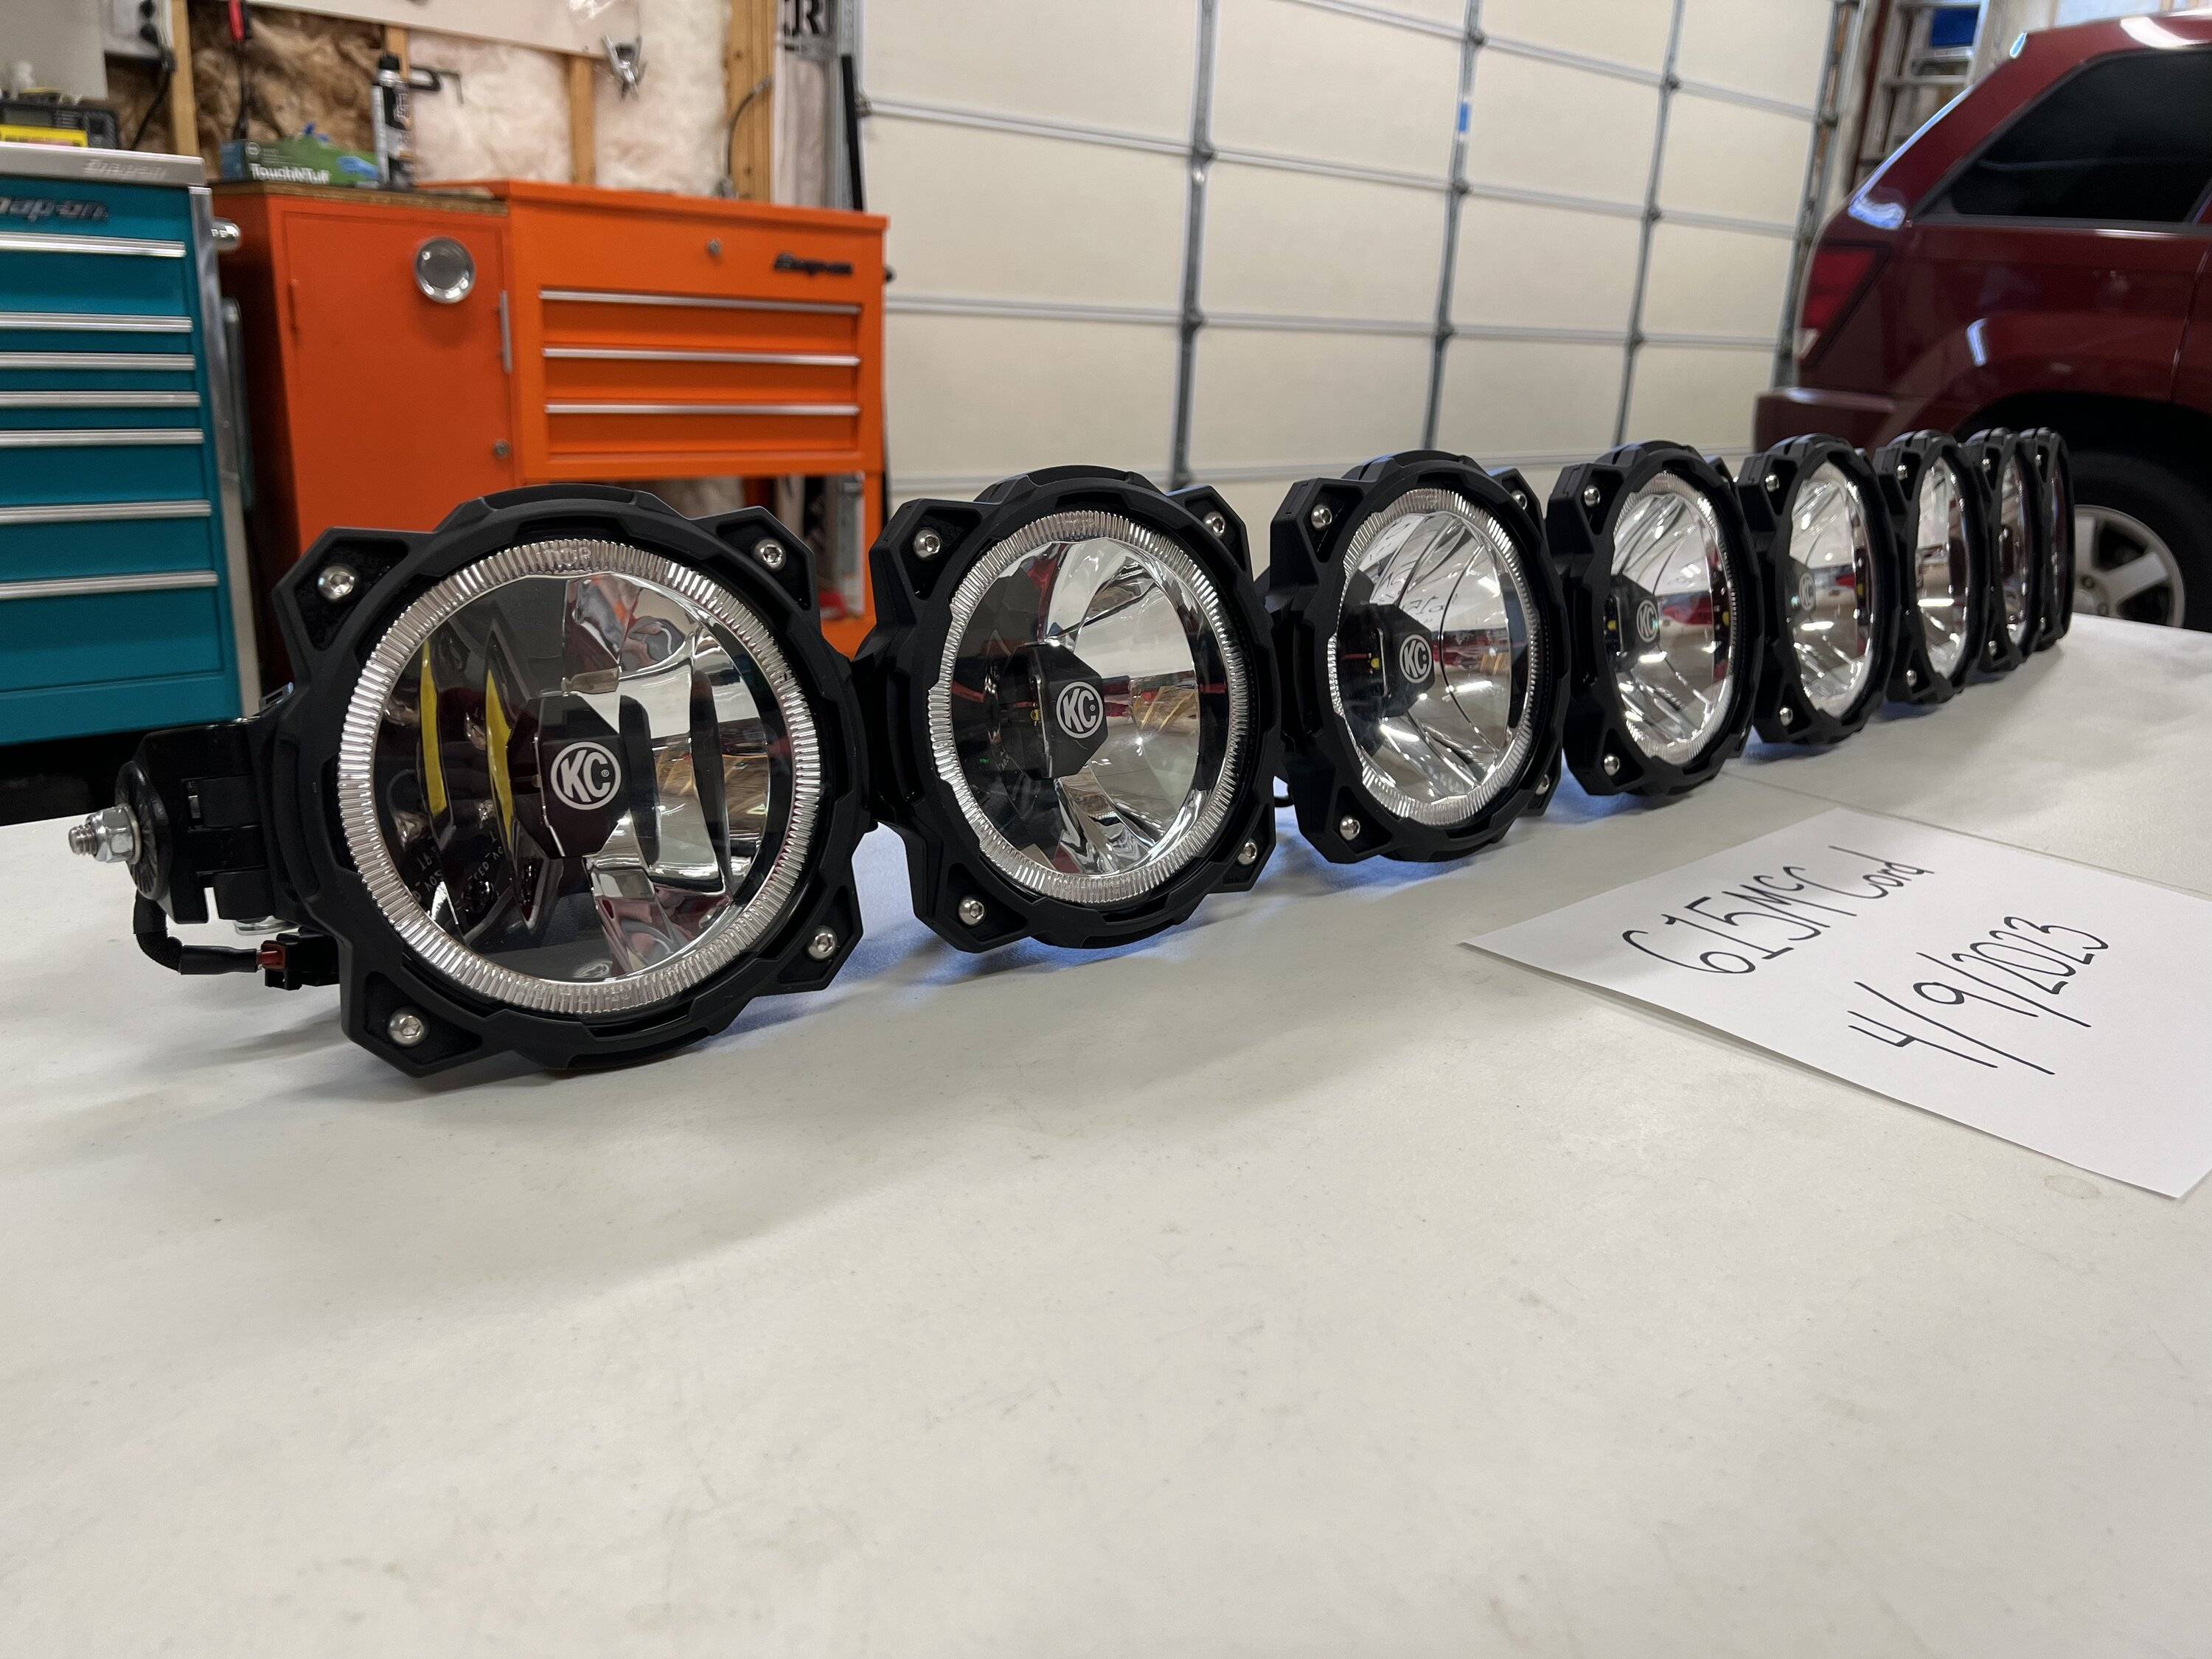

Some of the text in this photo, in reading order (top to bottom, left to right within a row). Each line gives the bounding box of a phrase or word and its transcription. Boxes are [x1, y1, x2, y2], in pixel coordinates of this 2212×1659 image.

[1404, 639, 1427, 678] KC
[1062, 688, 1096, 732] KC
[560, 749, 611, 802] KC
[1846, 916, 2109, 1075] 4/9/2023
